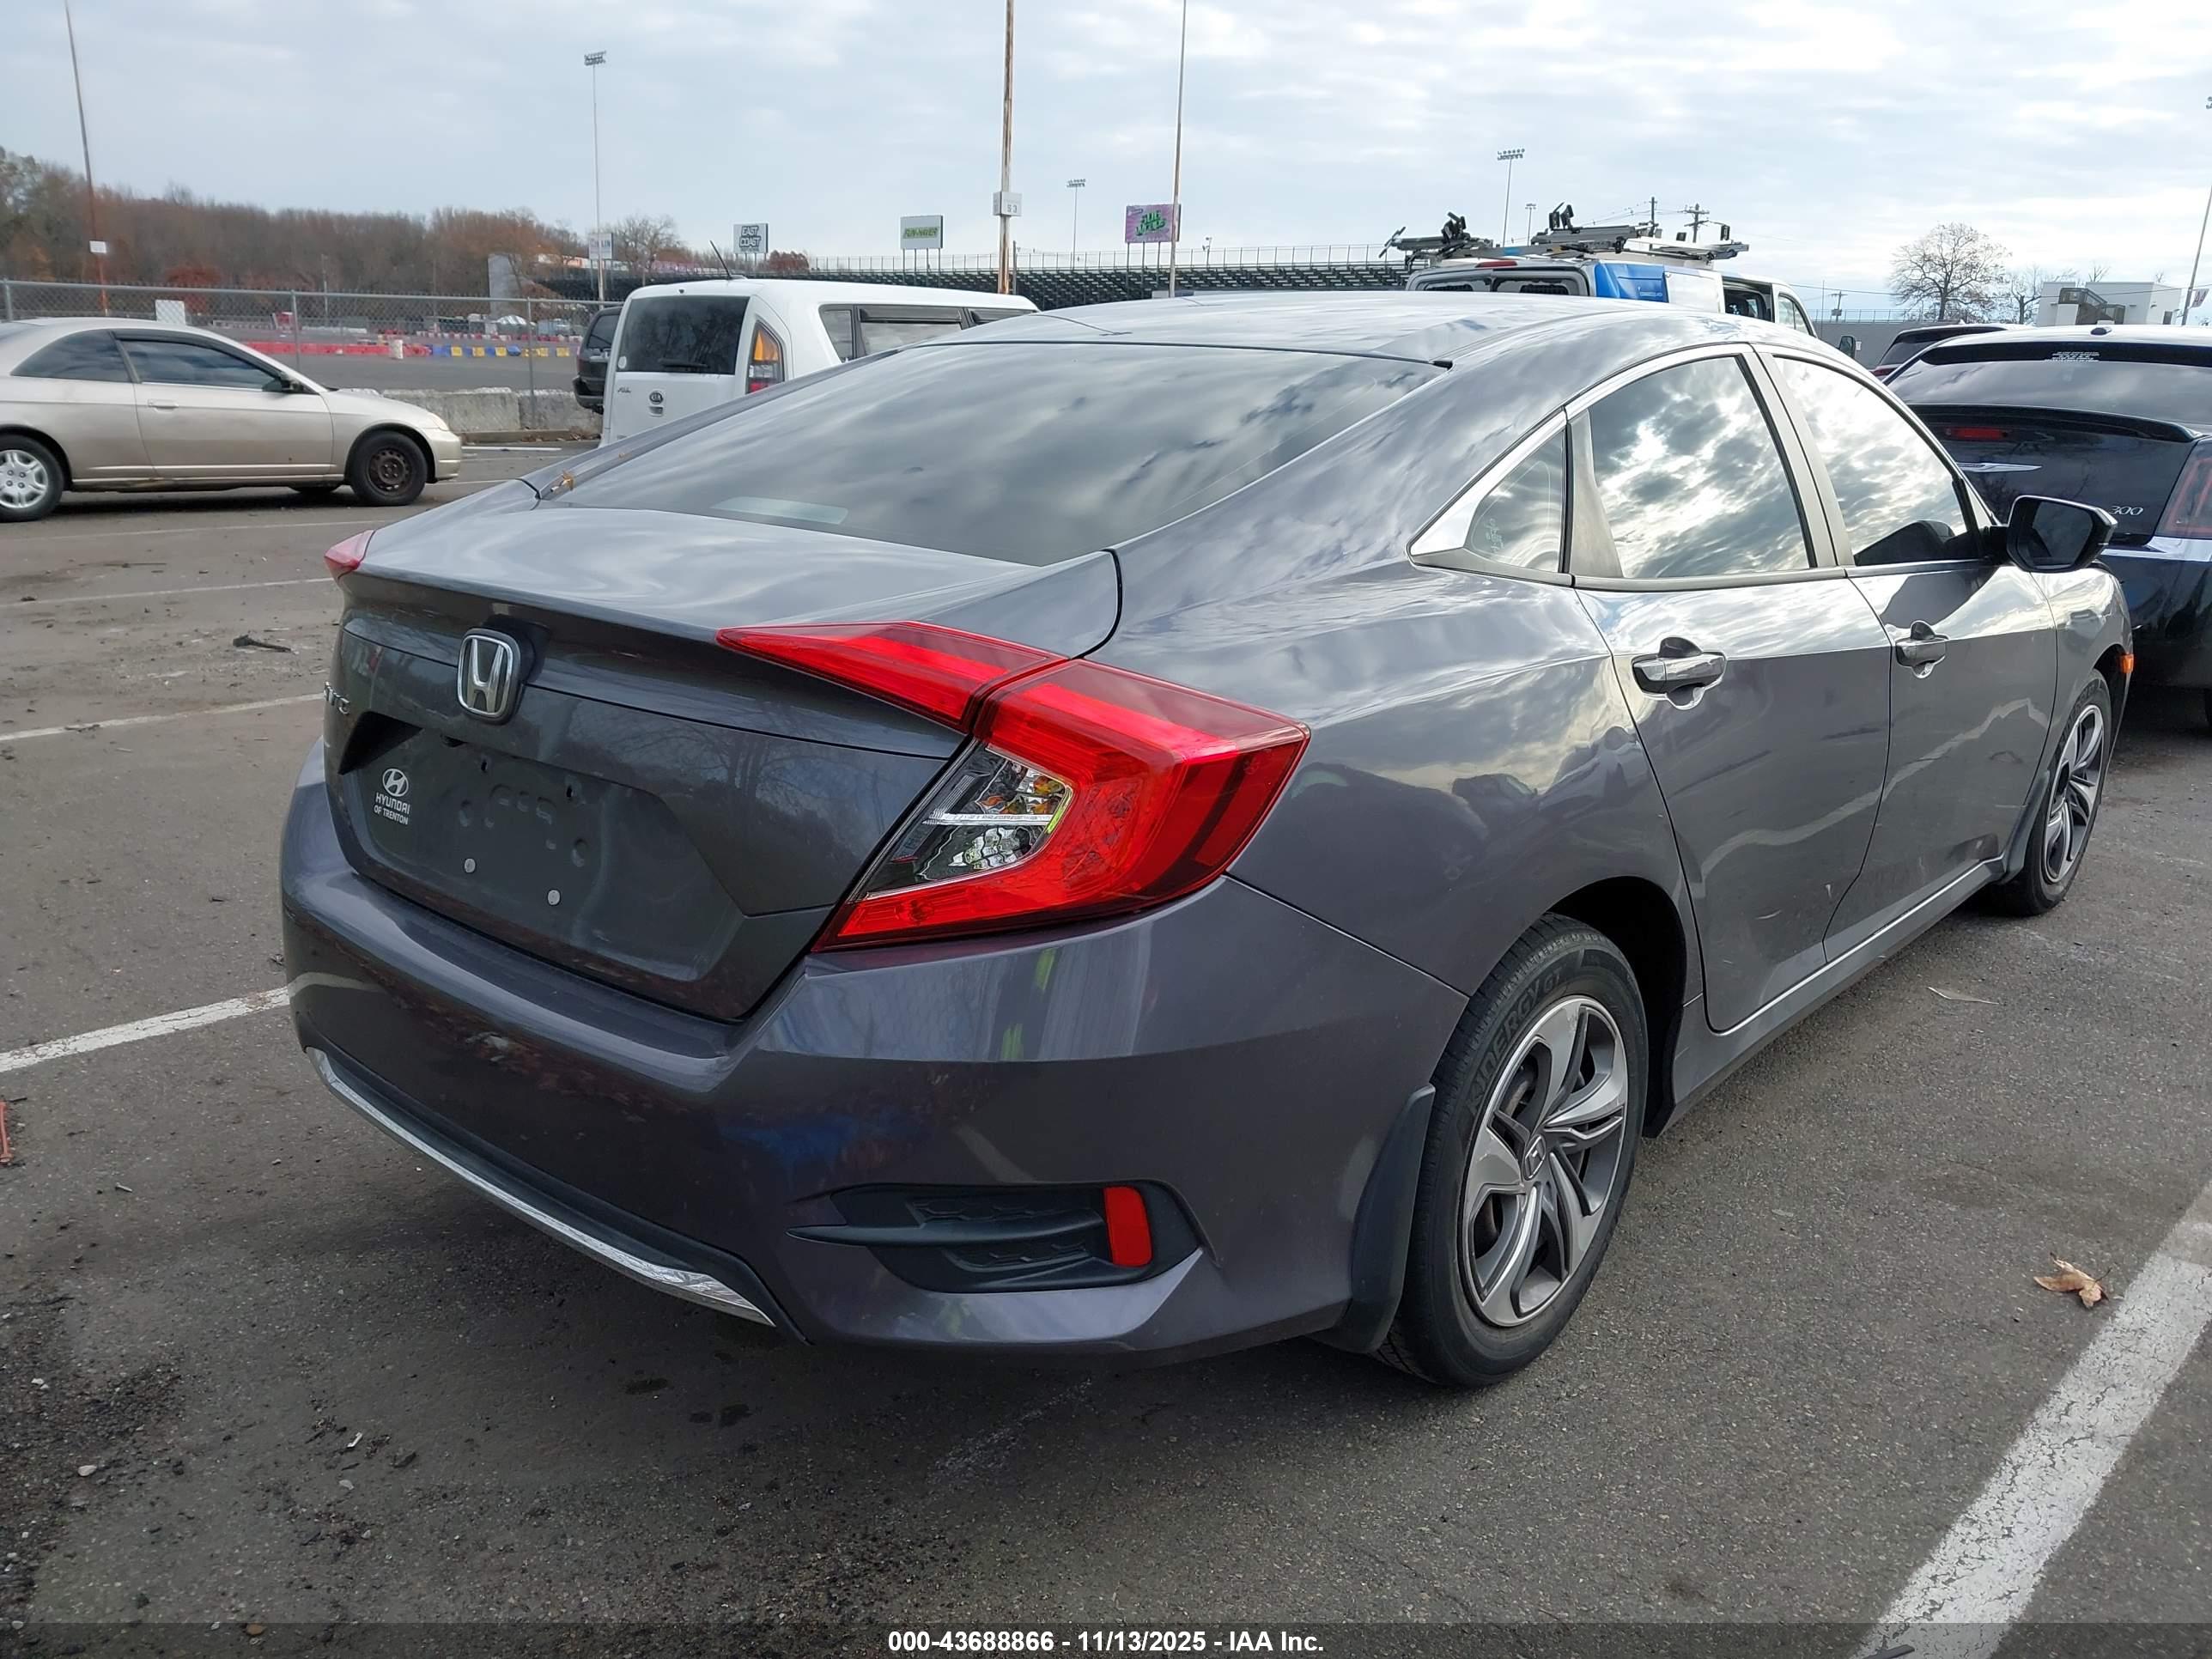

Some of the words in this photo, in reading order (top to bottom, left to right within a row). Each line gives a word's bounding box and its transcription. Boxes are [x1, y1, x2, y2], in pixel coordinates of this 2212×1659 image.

[741, 225, 759, 236] EAST
[739, 236, 761, 247] COAST
[2109, 505, 2143, 516] 300
[375, 792, 410, 815] HYUNDAI
[374, 805, 382, 815] OF
[383, 807, 409, 825] TRENTON
